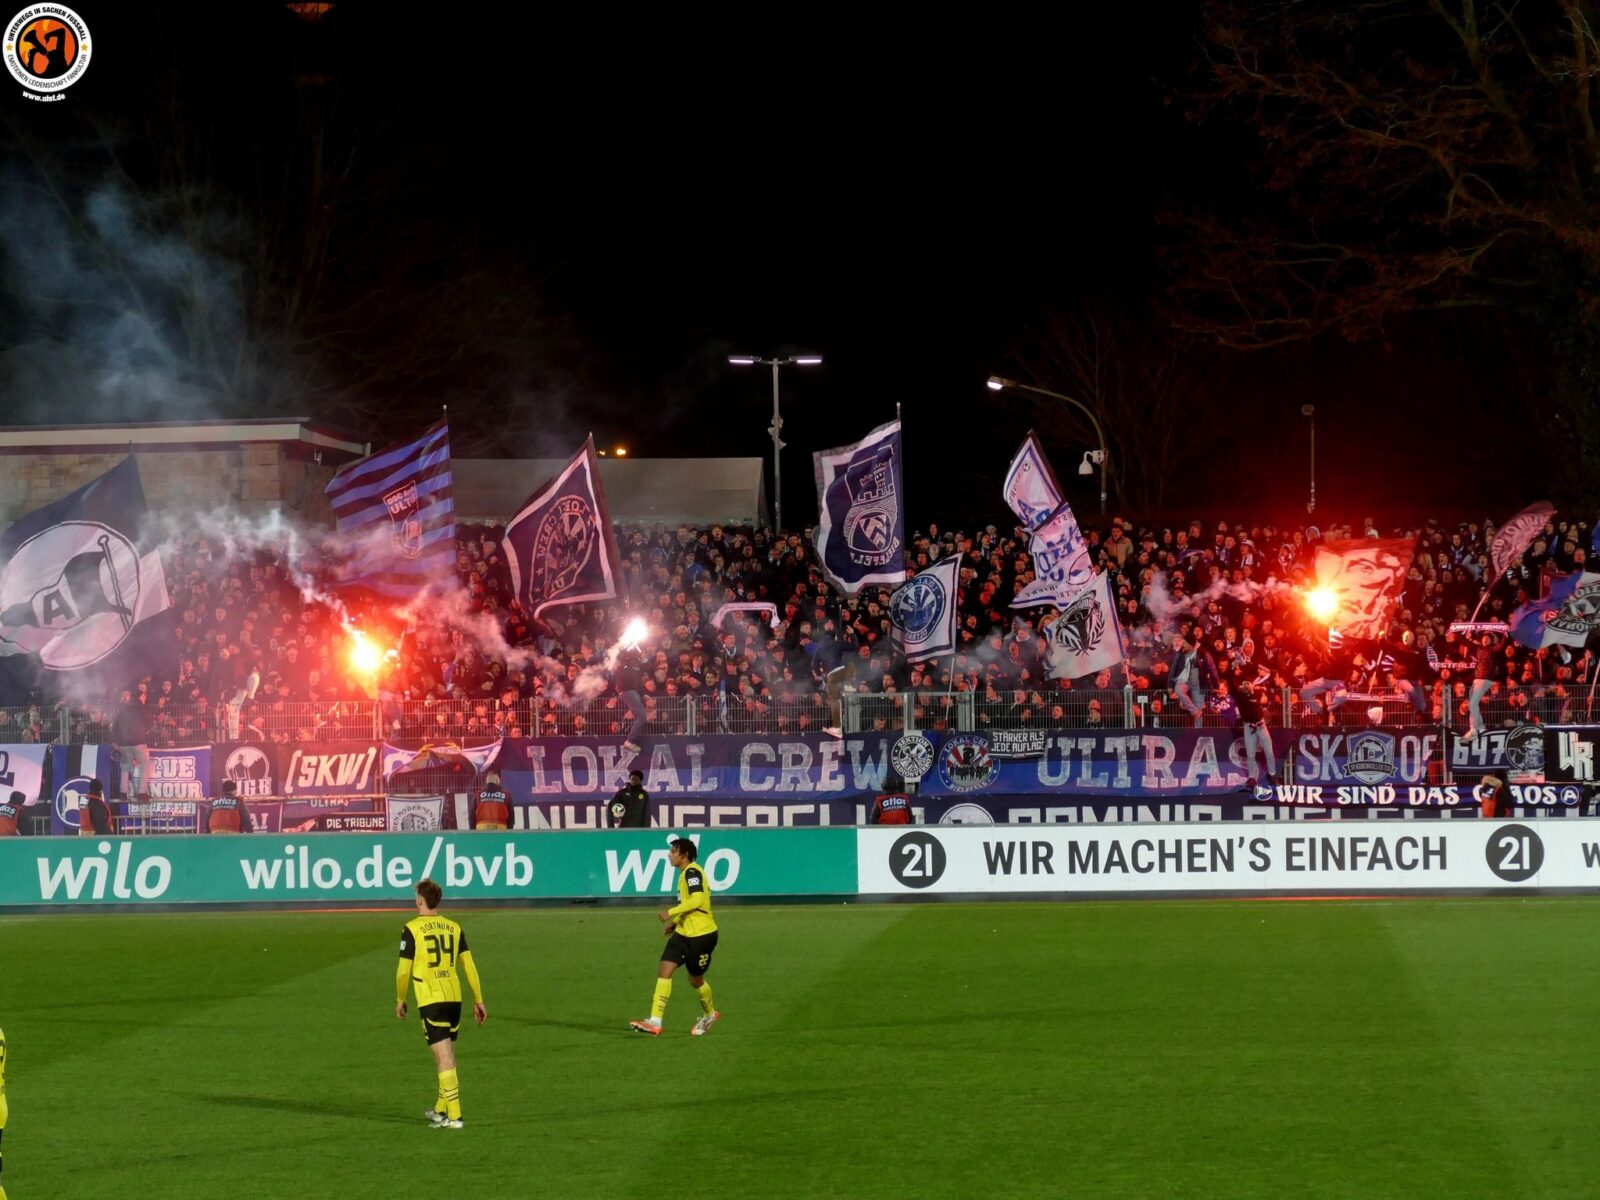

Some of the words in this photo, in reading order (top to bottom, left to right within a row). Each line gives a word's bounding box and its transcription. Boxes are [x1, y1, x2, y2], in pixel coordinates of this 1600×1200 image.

[1030, 731, 1044, 741] ALS
[1452, 735, 1506, 765] 647
[527, 743, 718, 795] LOKAL
[740, 739, 888, 792] CREW
[1037, 734, 1259, 788] ULTRAS
[1276, 784, 1324, 804] WIR
[1337, 785, 1395, 805] SIND
[1409, 785, 1460, 805] DAS
[1473, 784, 1557, 805] CAOS
[326, 818, 341, 829] DIE
[240, 836, 534, 889] wilo.de/bvb
[901, 843, 934, 877] 21
[983, 840, 1055, 875] WIR
[1284, 836, 1448, 871] EINFACH
[1498, 836, 1531, 870] 21
[37, 841, 172, 900] wilo
[419, 921, 455, 934] DORTMUND
[423, 934, 454, 968] 34
